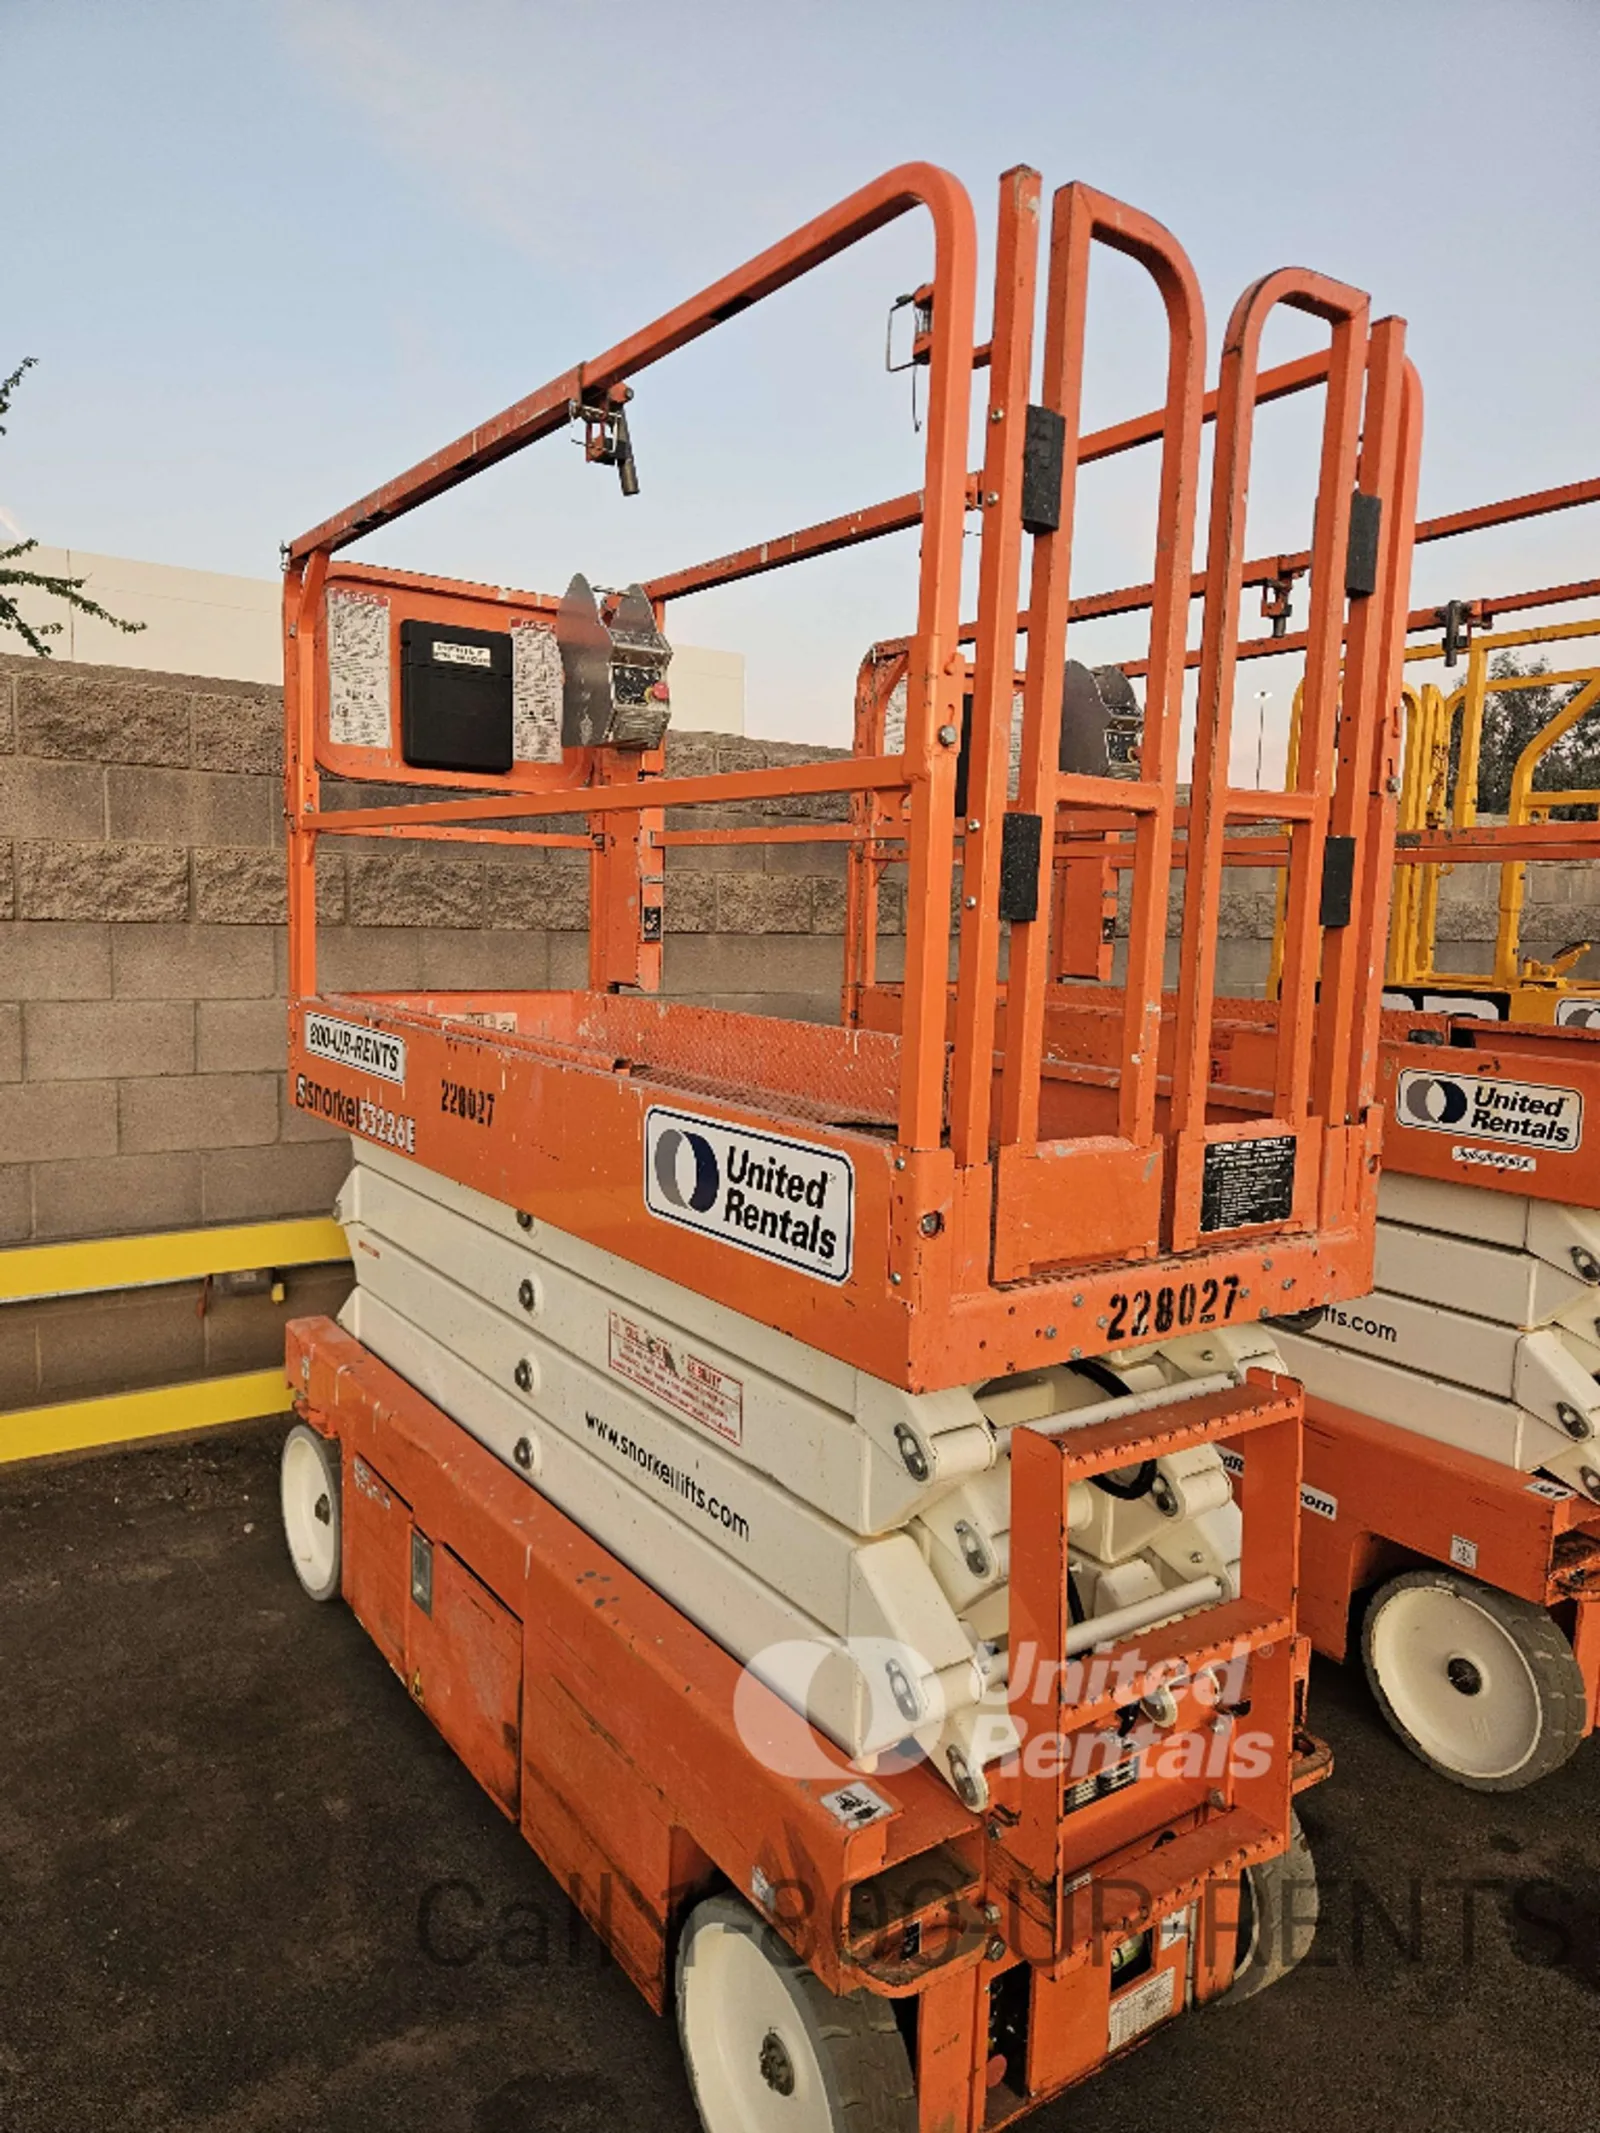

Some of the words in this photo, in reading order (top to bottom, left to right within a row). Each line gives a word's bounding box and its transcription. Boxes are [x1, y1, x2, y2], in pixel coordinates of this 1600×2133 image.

[1470, 1109, 1570, 1142] Rentals
[1474, 1085, 1564, 1117] United
[726, 1145, 828, 1209] United
[723, 1187, 837, 1259] Rentals
[1107, 1274, 1239, 1341] 228027
[585, 1410, 750, 1542] www.snorkellifts.com
